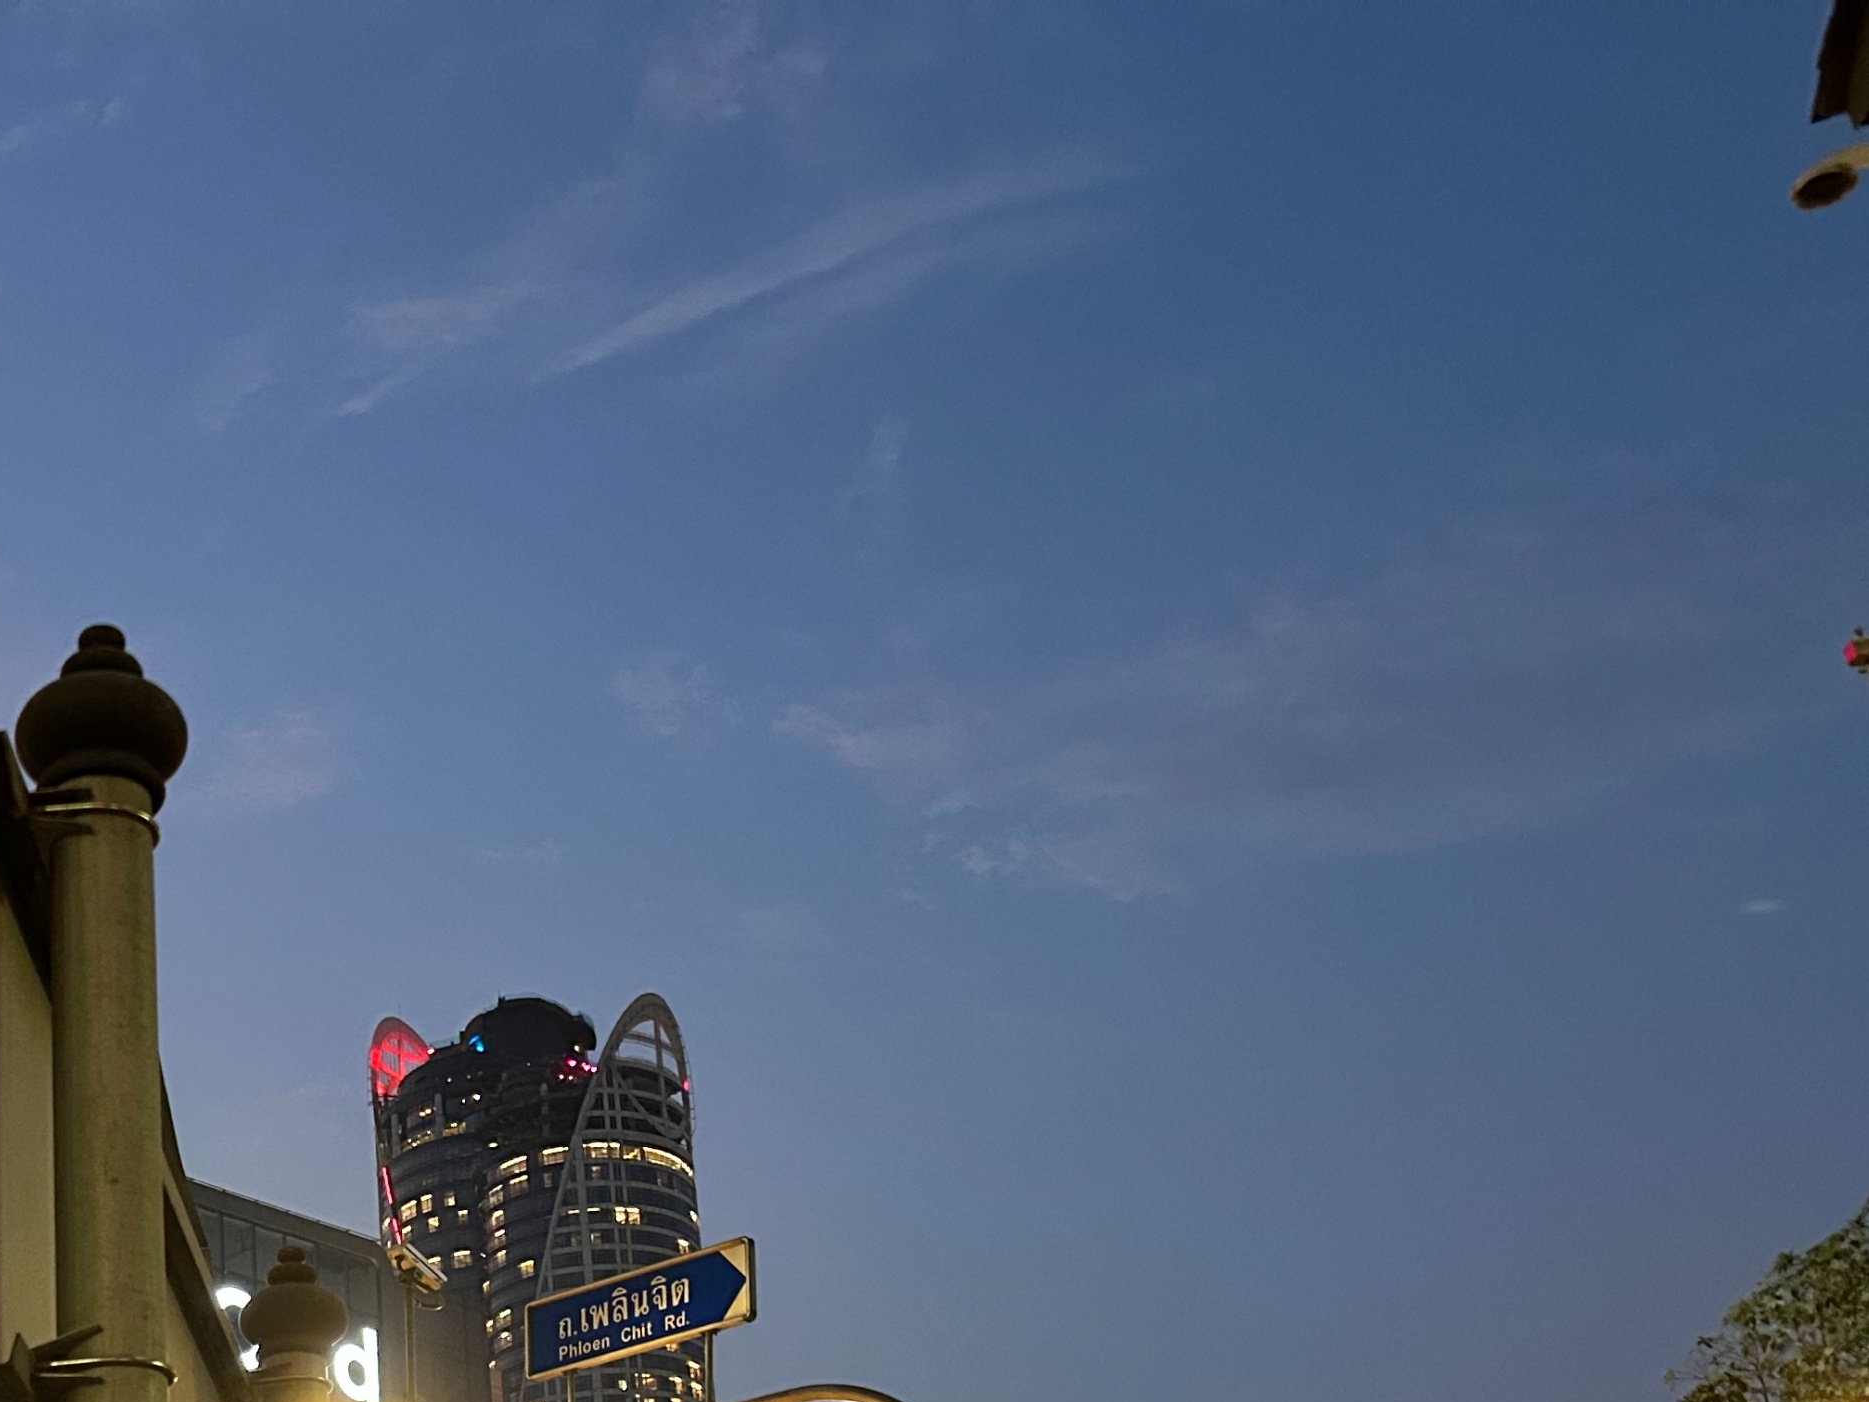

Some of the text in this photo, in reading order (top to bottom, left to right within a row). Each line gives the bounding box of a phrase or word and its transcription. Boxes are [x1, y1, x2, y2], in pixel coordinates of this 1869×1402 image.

[559, 1310, 691, 1362] Phloen Chit Rd.
